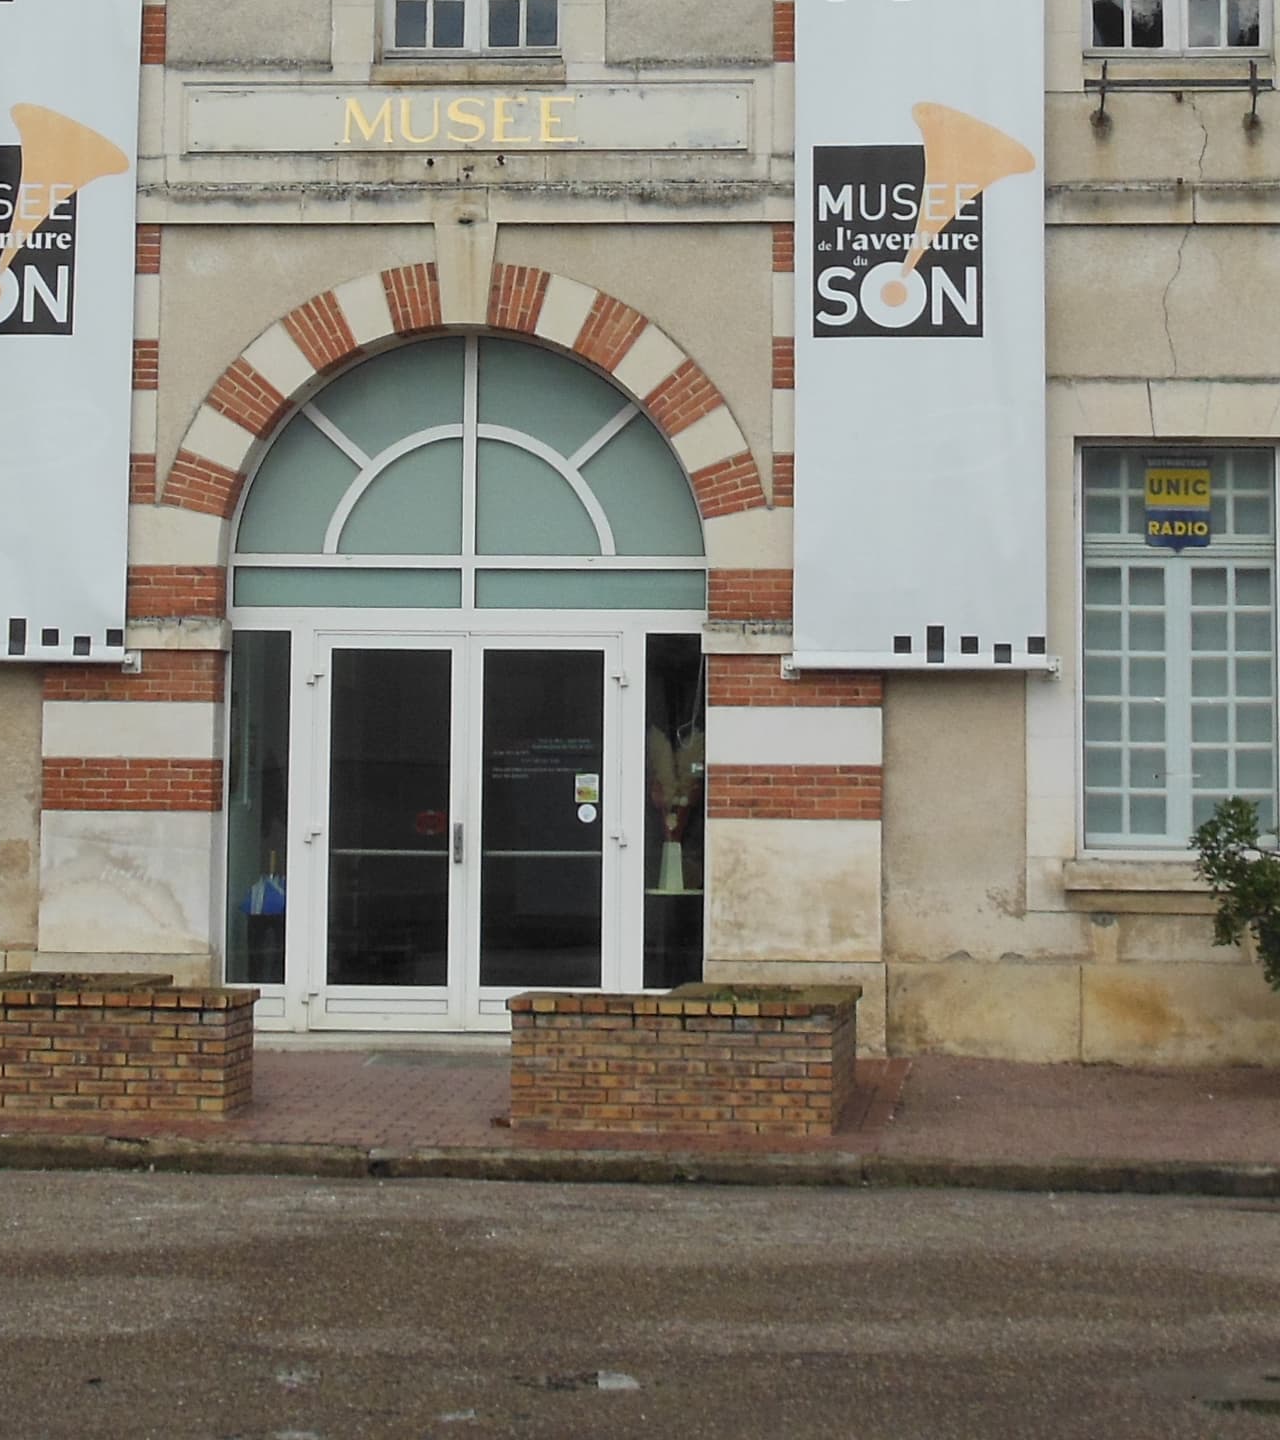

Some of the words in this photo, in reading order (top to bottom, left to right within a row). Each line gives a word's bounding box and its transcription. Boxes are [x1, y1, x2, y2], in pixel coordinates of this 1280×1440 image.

[342, 96, 578, 144] MUSEE
[818, 183, 979, 222] MUSEE
[817, 239, 833, 252] de
[835, 226, 980, 251] l'aventure
[853, 255, 868, 266] du
[815, 261, 978, 329] SON
[1148, 478, 1208, 496] UNIC
[1147, 520, 1209, 536] RADIO
